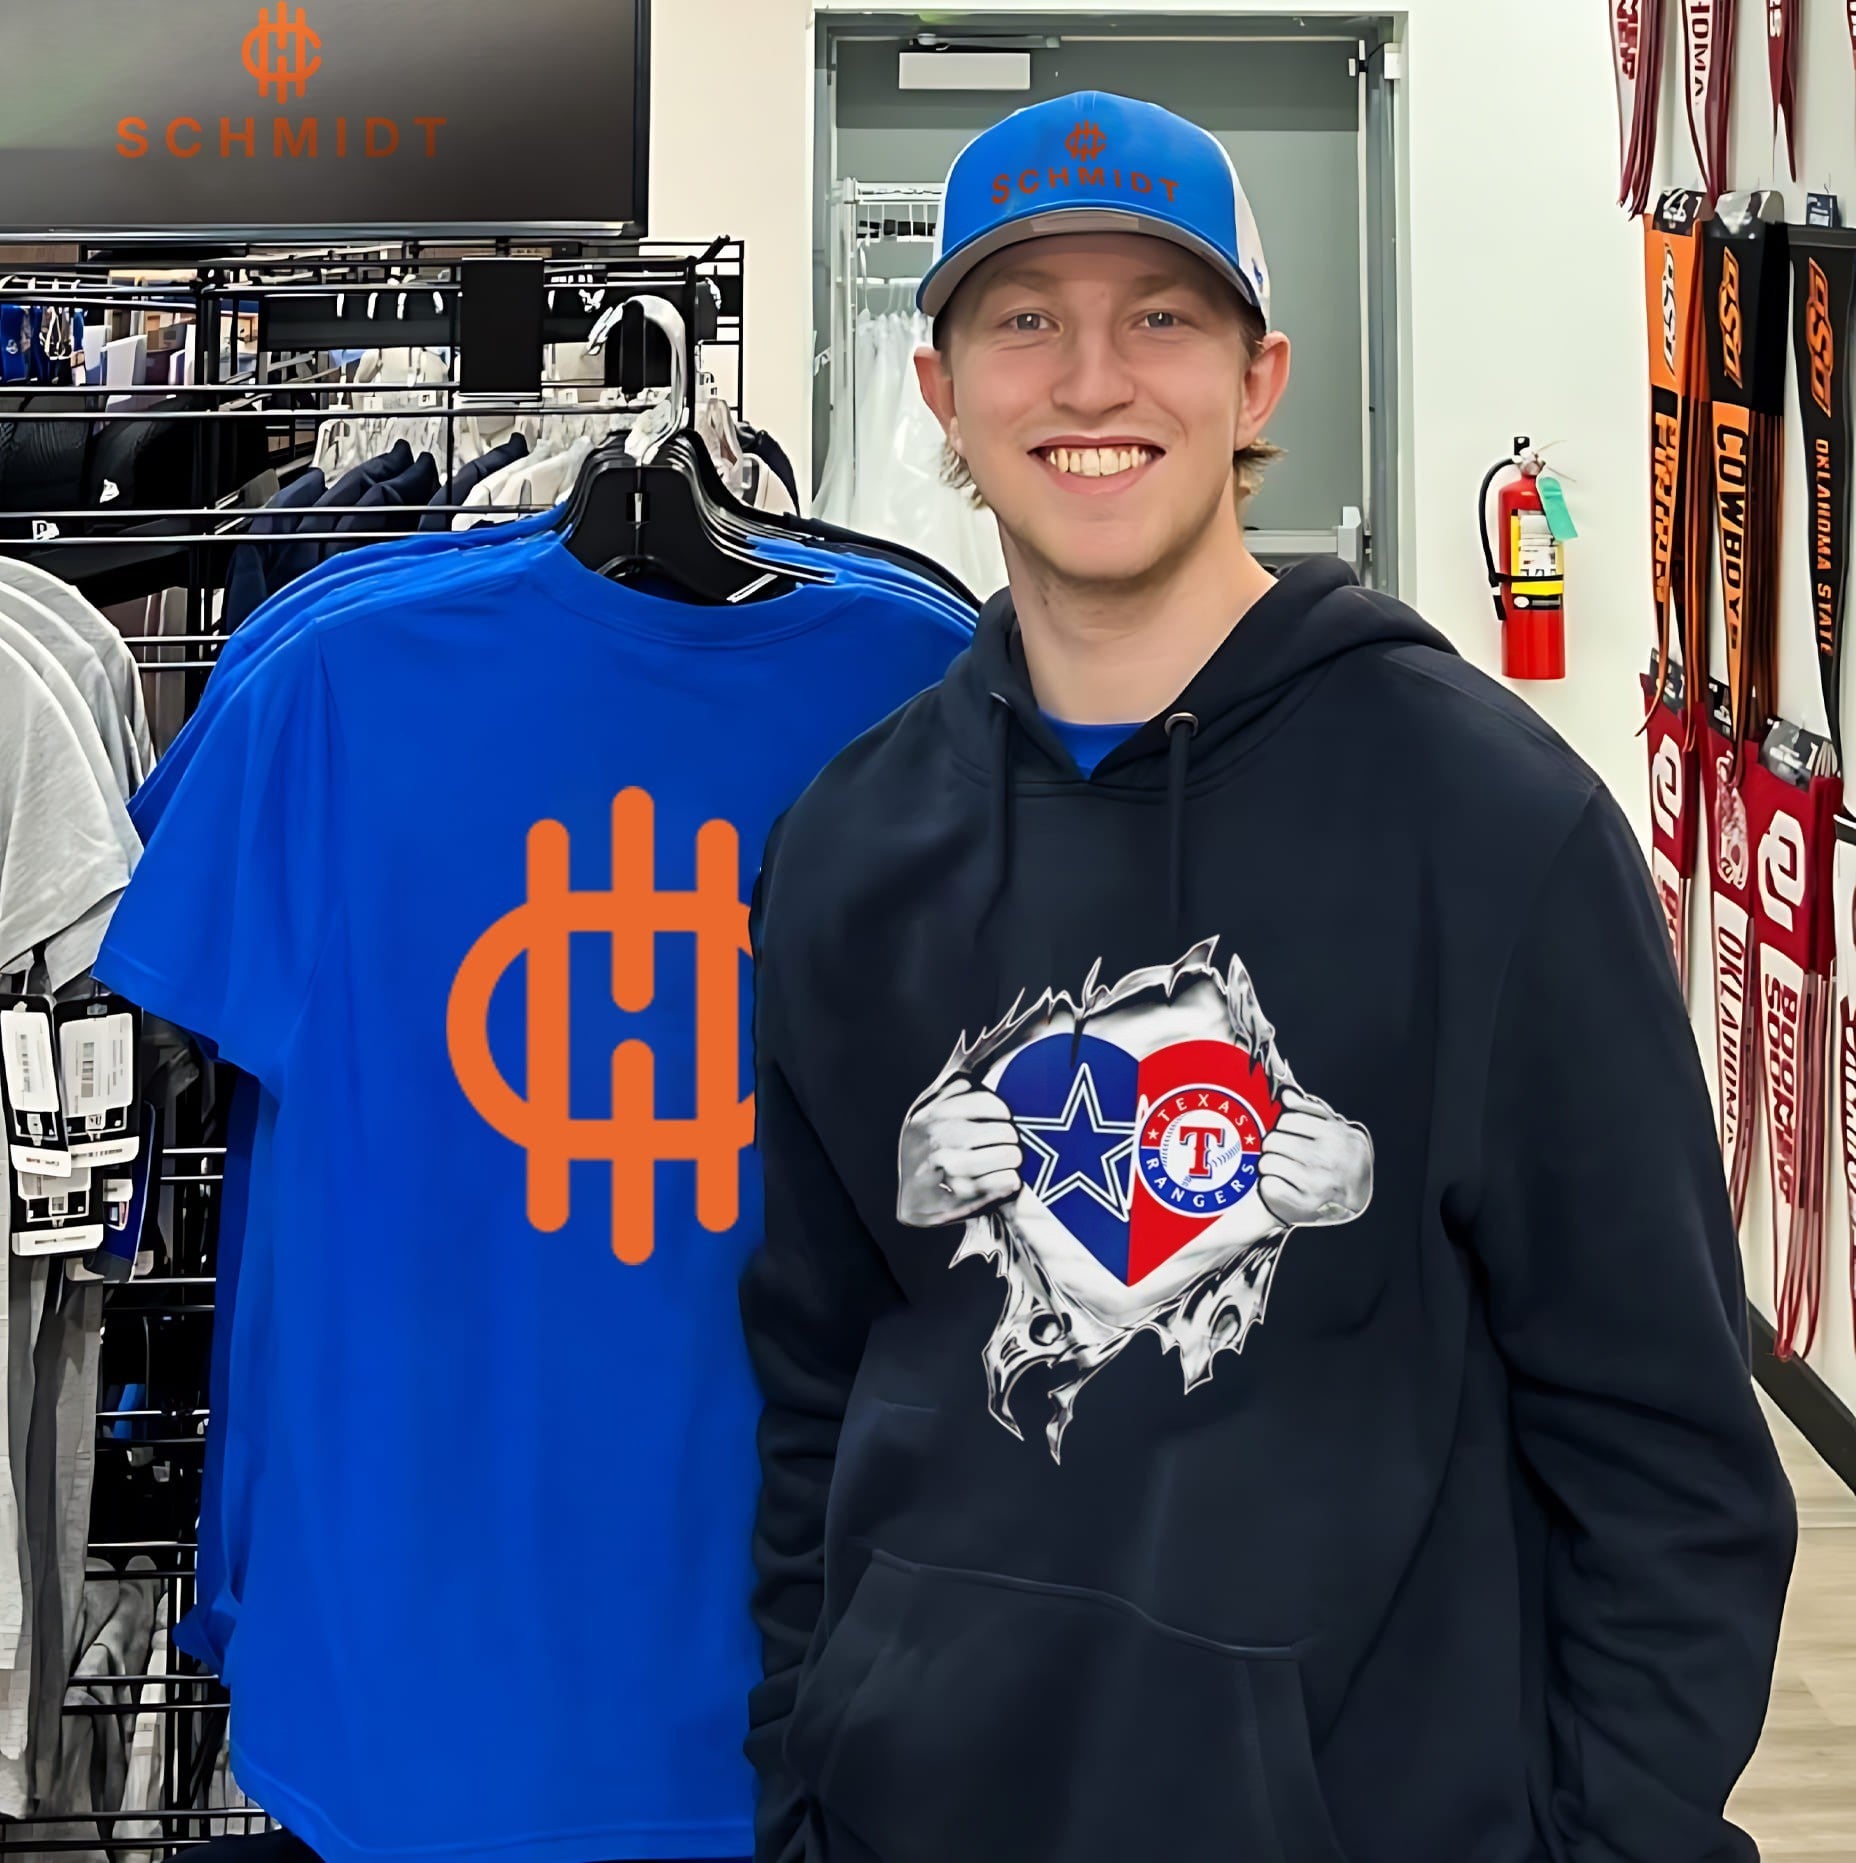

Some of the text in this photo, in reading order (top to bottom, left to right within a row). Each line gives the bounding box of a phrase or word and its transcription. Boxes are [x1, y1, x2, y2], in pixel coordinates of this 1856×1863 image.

[116, 117, 447, 159] SCHMIDT
[991, 166, 1179, 205] SCHMIDT
[1157, 1093, 1249, 1127] TEXAS
[1178, 1125, 1226, 1180] T
[1146, 1157, 1255, 1208] RANGERS
